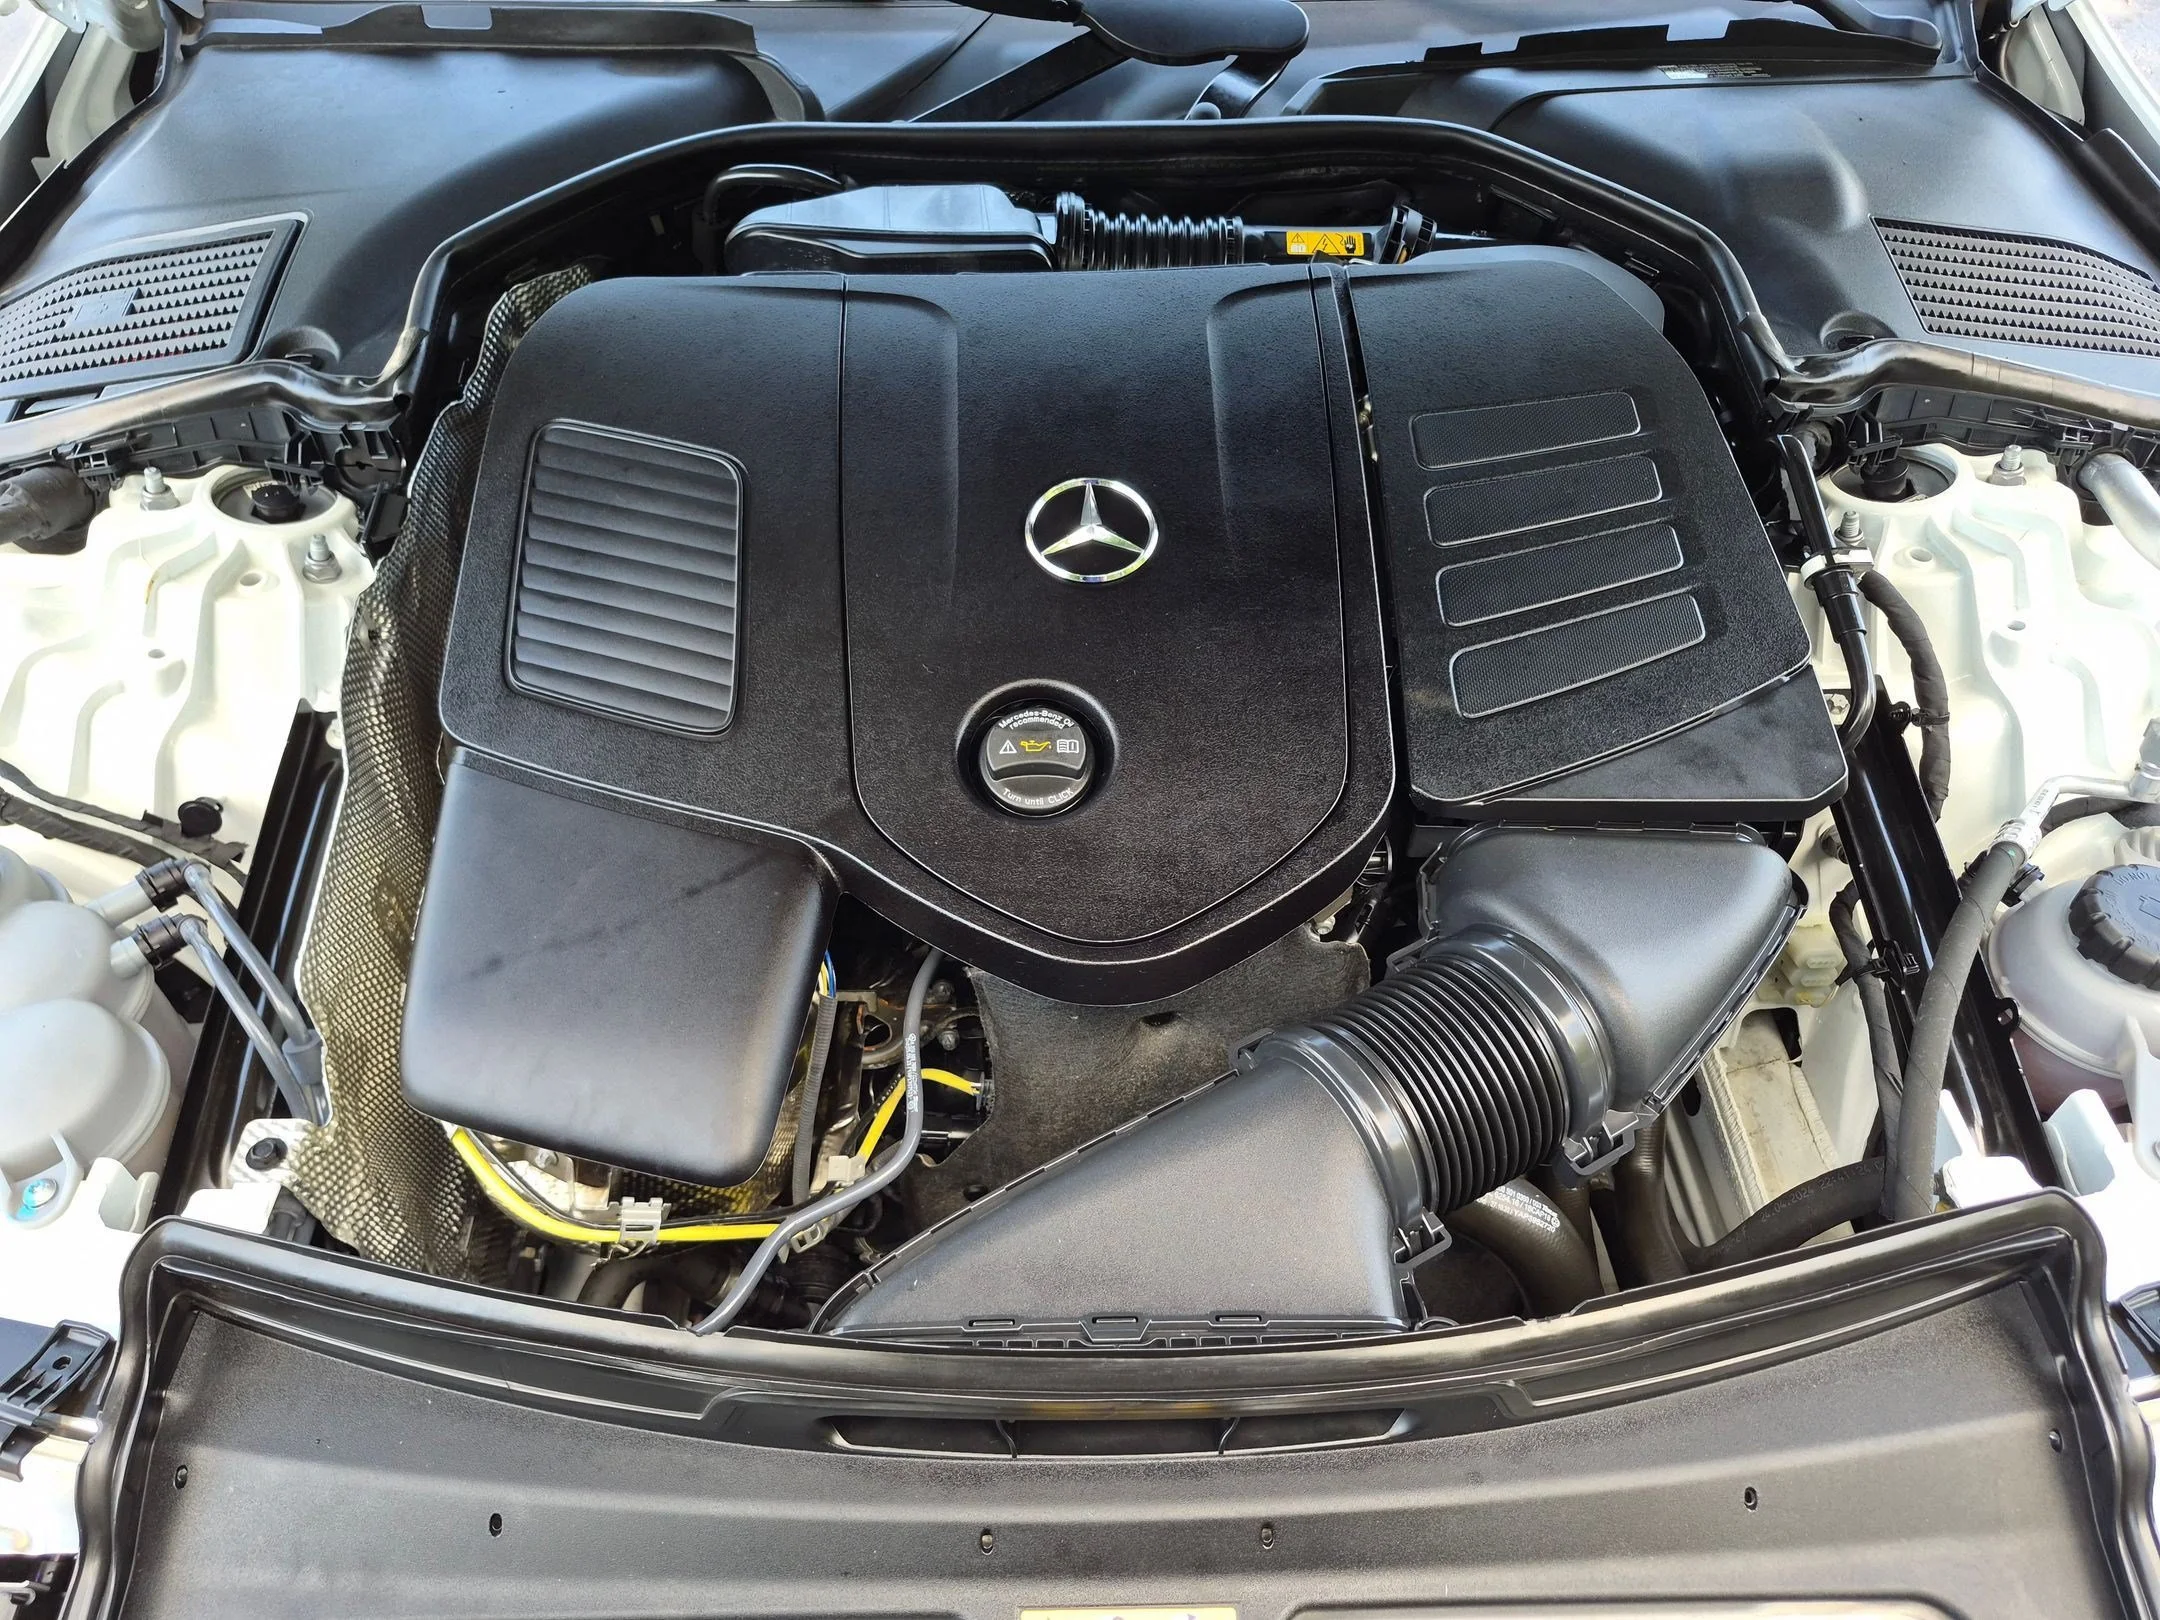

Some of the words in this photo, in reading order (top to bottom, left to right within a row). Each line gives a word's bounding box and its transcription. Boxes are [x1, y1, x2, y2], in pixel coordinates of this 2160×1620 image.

[998, 710, 1063, 729] Mercedes-Benz
[1063, 717, 1075, 728] Oil
[1009, 716, 1065, 730] recommended
[1002, 788, 1022, 802] Turn
[1025, 797, 1044, 806] until
[1047, 787, 1074, 804] CLICK
